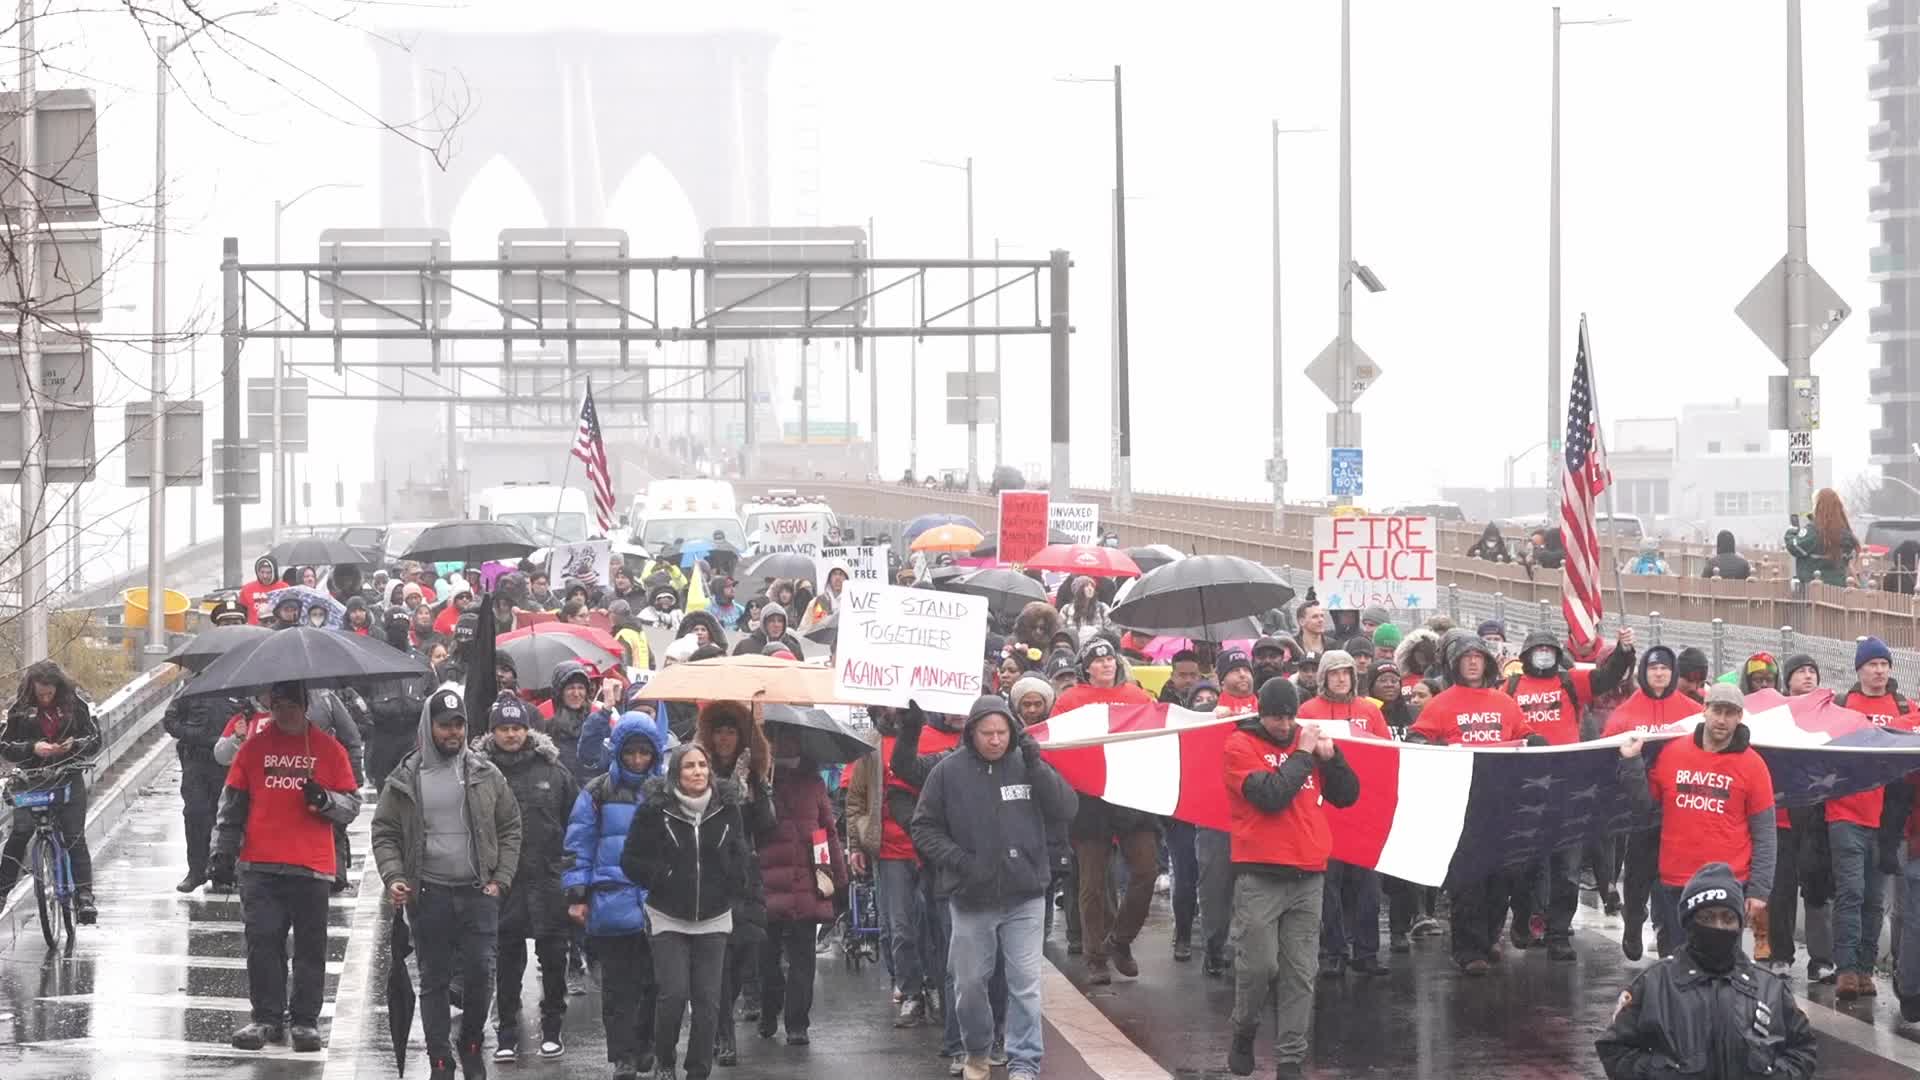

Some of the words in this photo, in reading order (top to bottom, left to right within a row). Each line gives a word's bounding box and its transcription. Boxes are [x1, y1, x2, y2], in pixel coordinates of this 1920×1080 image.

[1332, 467, 1360, 478] CALL
[1050, 506, 1093, 518] UNVAXED
[771, 519, 808, 534] VEGAN
[1333, 516, 1427, 549] FIRE
[821, 548, 848, 558] WHOM
[857, 547, 874, 557] THE
[1318, 549, 1434, 581] FAUCI
[854, 569, 877, 579] FREE
[849, 591, 881, 611] WE
[901, 596, 969, 618] STAND
[1350, 592, 1397, 609] USA
[859, 619, 952, 649] TOGETHER
[842, 658, 904, 688] AGAINST
[910, 665, 981, 691] MANDATES
[1517, 690, 1562, 706] BRAVEST
[1456, 711, 1502, 726] BRAVEST
[1462, 729, 1502, 742] CHOICE
[264, 754, 317, 769] BRAVEST
[264, 775, 307, 791] CHOIC
[1676, 769, 1733, 790] BRAVEST
[1675, 794, 1725, 814] CHOICE
[1686, 888, 1728, 910] NYPD
